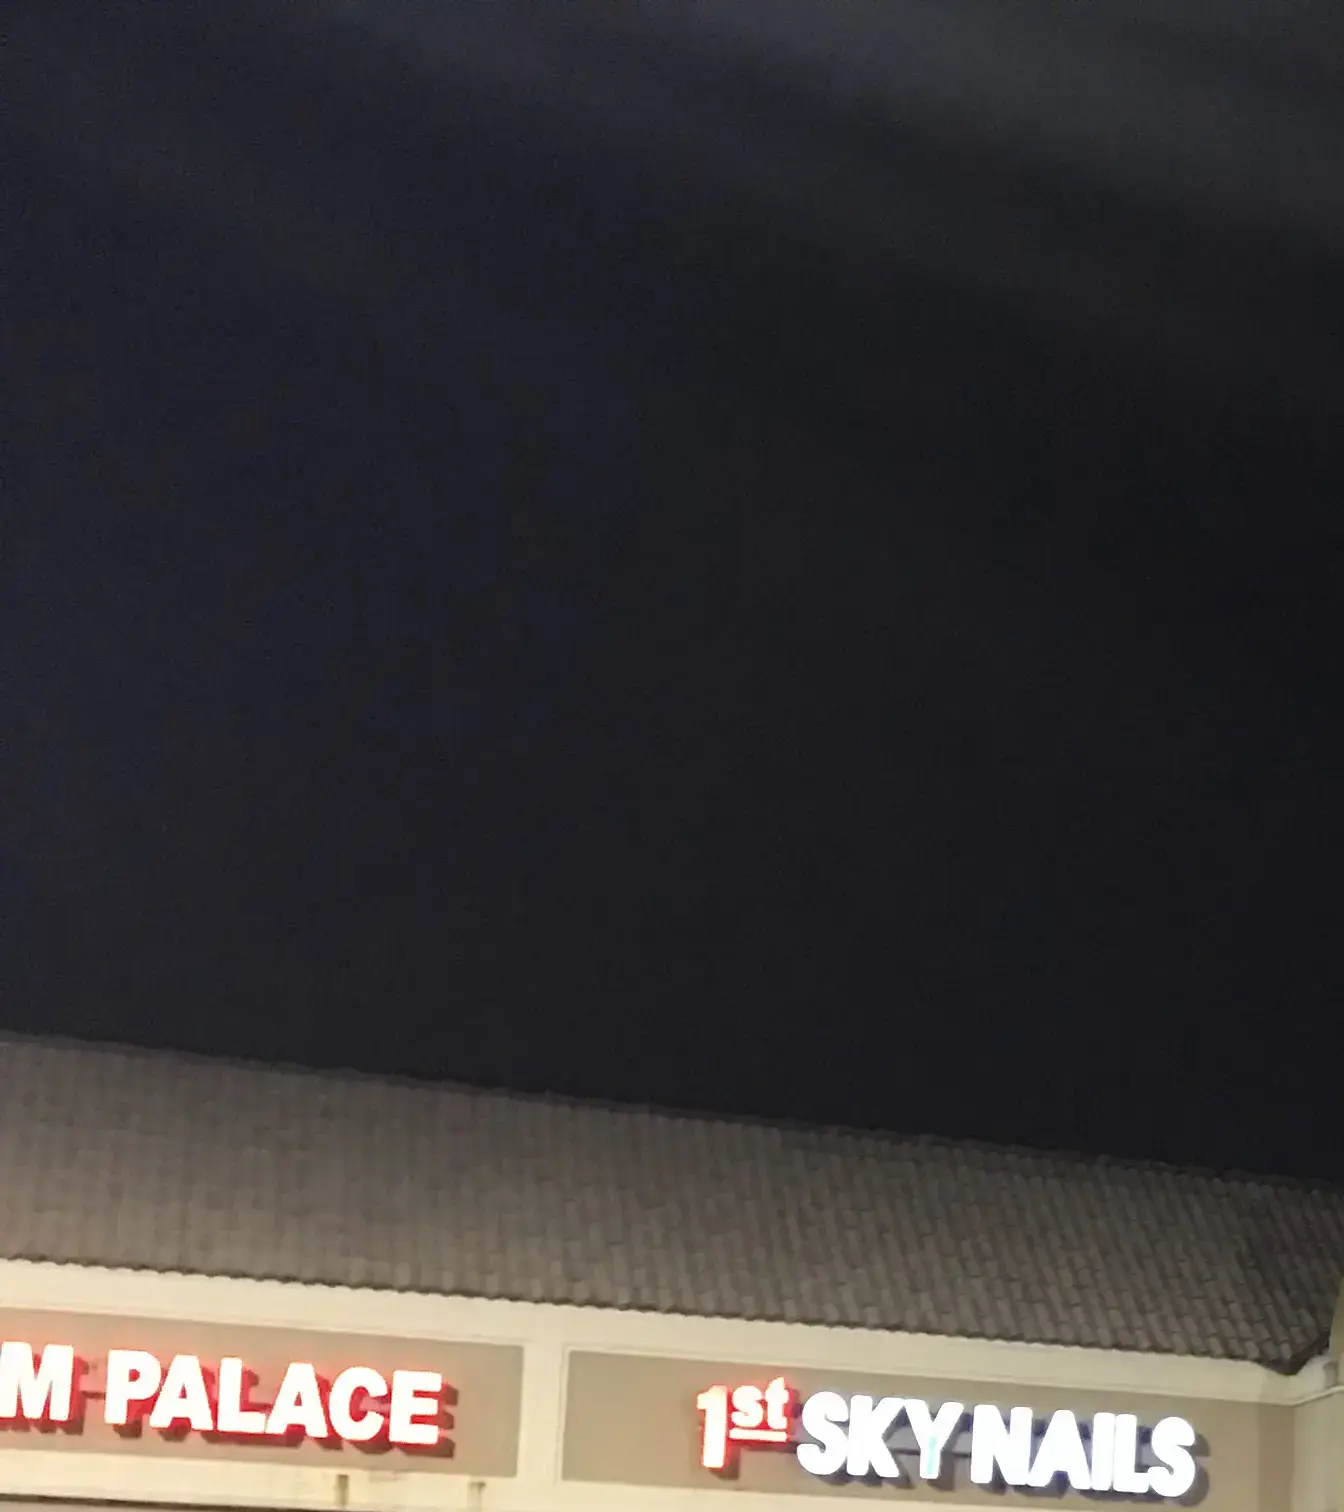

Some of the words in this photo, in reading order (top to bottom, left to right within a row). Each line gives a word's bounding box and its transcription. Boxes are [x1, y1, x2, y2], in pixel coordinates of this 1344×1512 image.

[103, 1349, 444, 1446] PALACE
[697, 1376, 790, 1469] 1st
[798, 1391, 964, 1480] SKY
[971, 1403, 1196, 1498] NAILS
